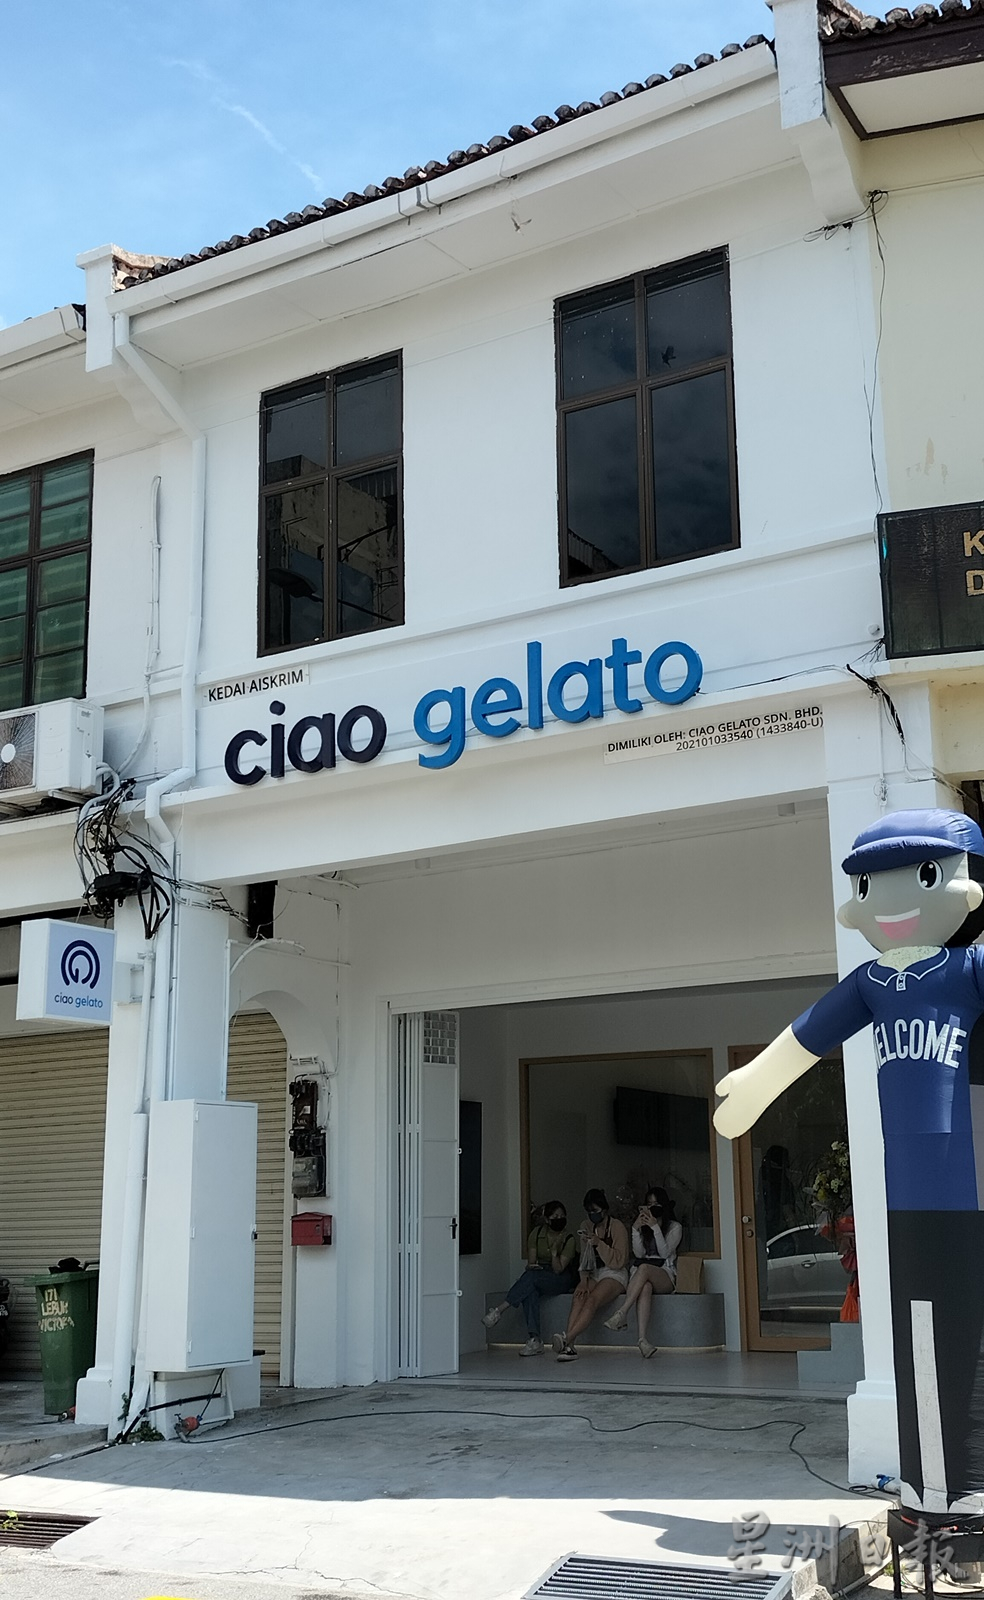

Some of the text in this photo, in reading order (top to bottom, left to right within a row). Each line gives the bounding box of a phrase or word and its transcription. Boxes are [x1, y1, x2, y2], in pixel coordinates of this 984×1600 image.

[208, 669, 304, 702] KEDAI AISKRIM
[224, 638, 704, 786] ciao gelato
[608, 706, 823, 752] DIMILIKI OLEH: CIAO GELATO SDN. BHD.
[676, 717, 824, 751] 202101033540 (1433840-U)
[54, 992, 103, 1008] ciao gelato
[873, 1018, 967, 1069] ELCOME
[45, 1288, 58, 1302] 171
